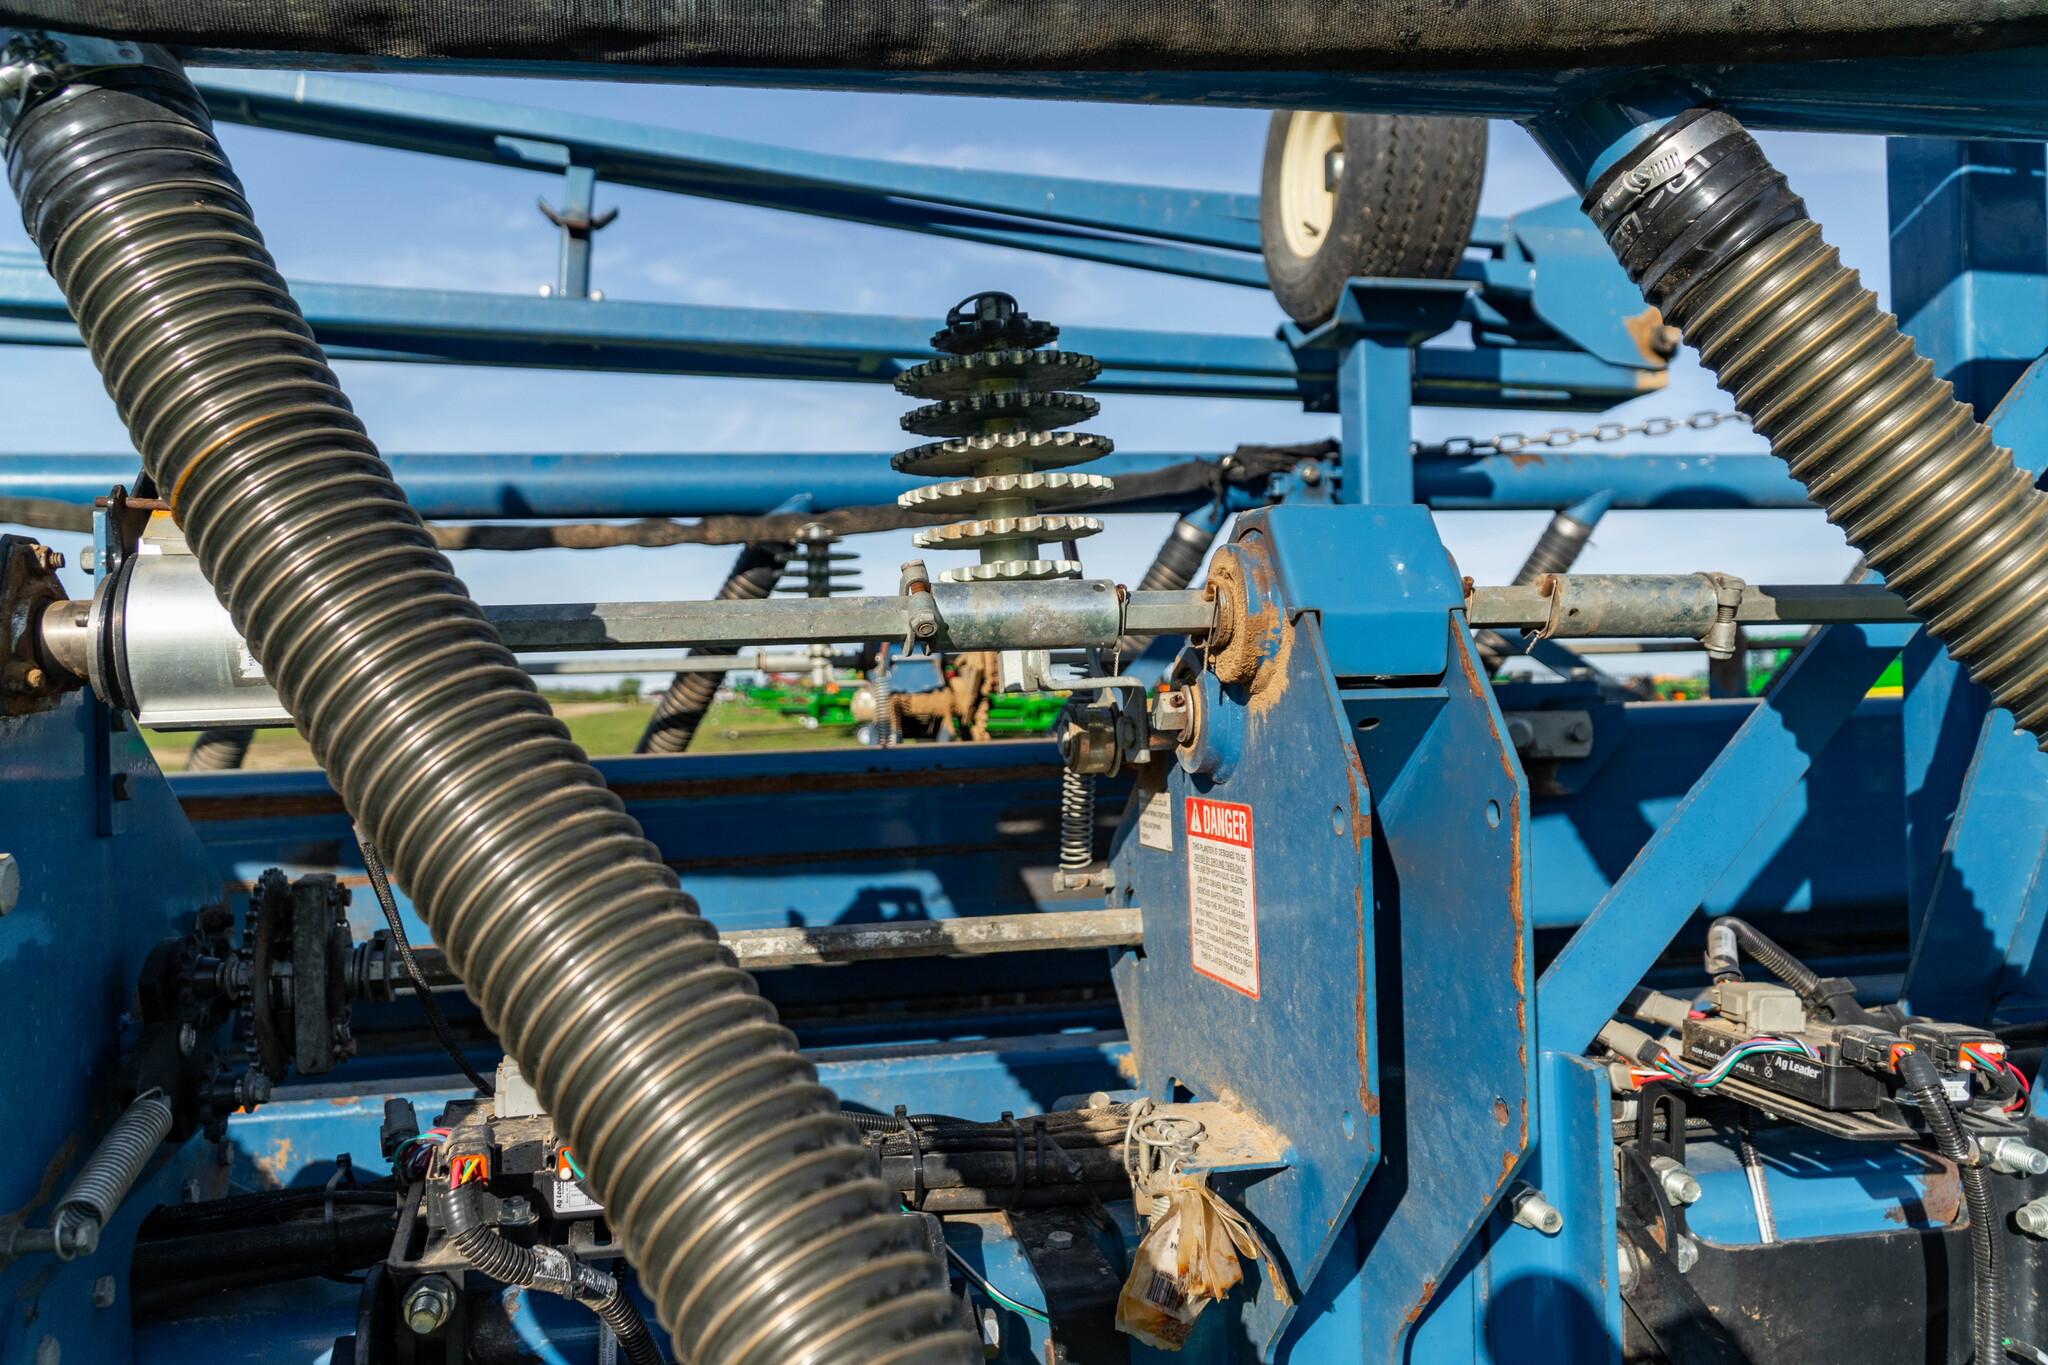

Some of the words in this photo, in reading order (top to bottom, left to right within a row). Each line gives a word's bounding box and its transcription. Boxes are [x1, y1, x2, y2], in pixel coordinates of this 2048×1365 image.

[1203, 805, 1248, 842] DANGER
[1775, 1056, 1789, 1071] Ag
[1789, 1060, 1820, 1079] Leader
